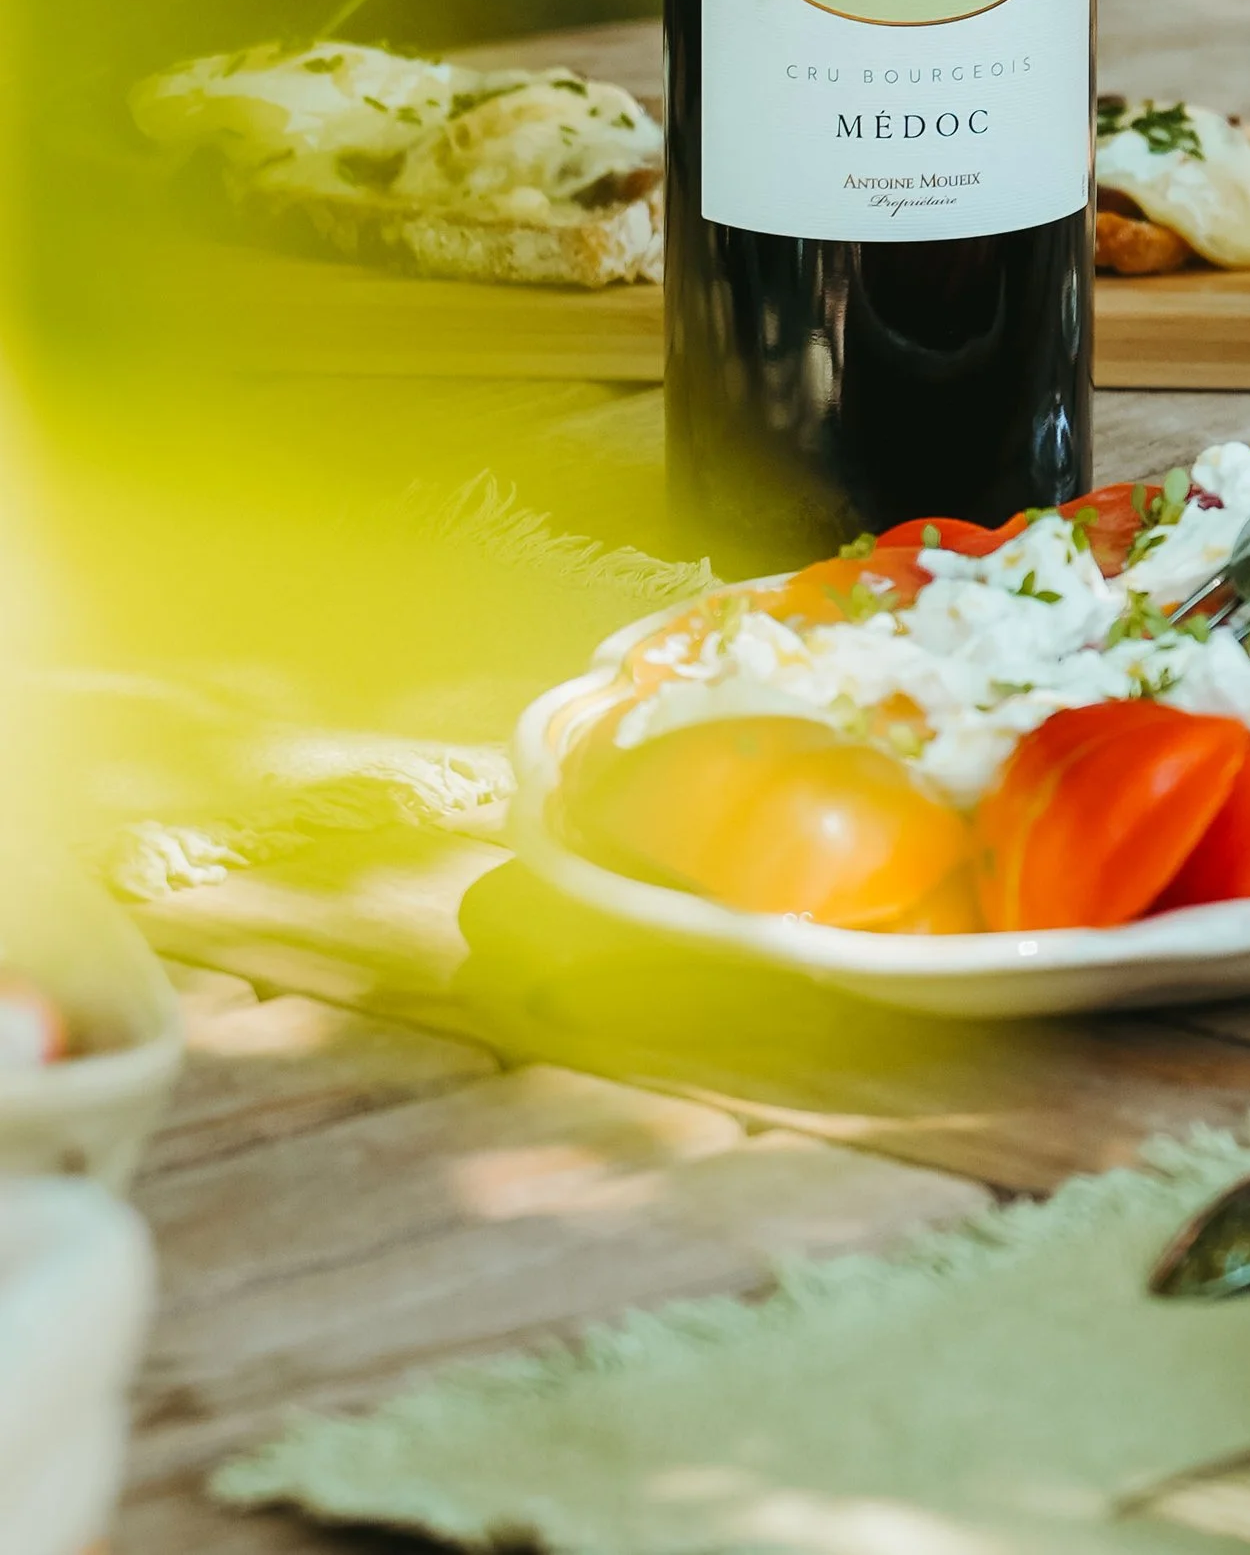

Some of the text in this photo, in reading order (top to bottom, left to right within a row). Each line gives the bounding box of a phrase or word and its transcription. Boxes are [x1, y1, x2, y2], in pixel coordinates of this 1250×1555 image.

[786, 56, 1032, 84] CRU BOURGEOIS
[836, 109, 990, 140] MÉDOC
[843, 171, 981, 190] ANTOINE MOUEIX
[868, 194, 957, 218] Propriétaire
